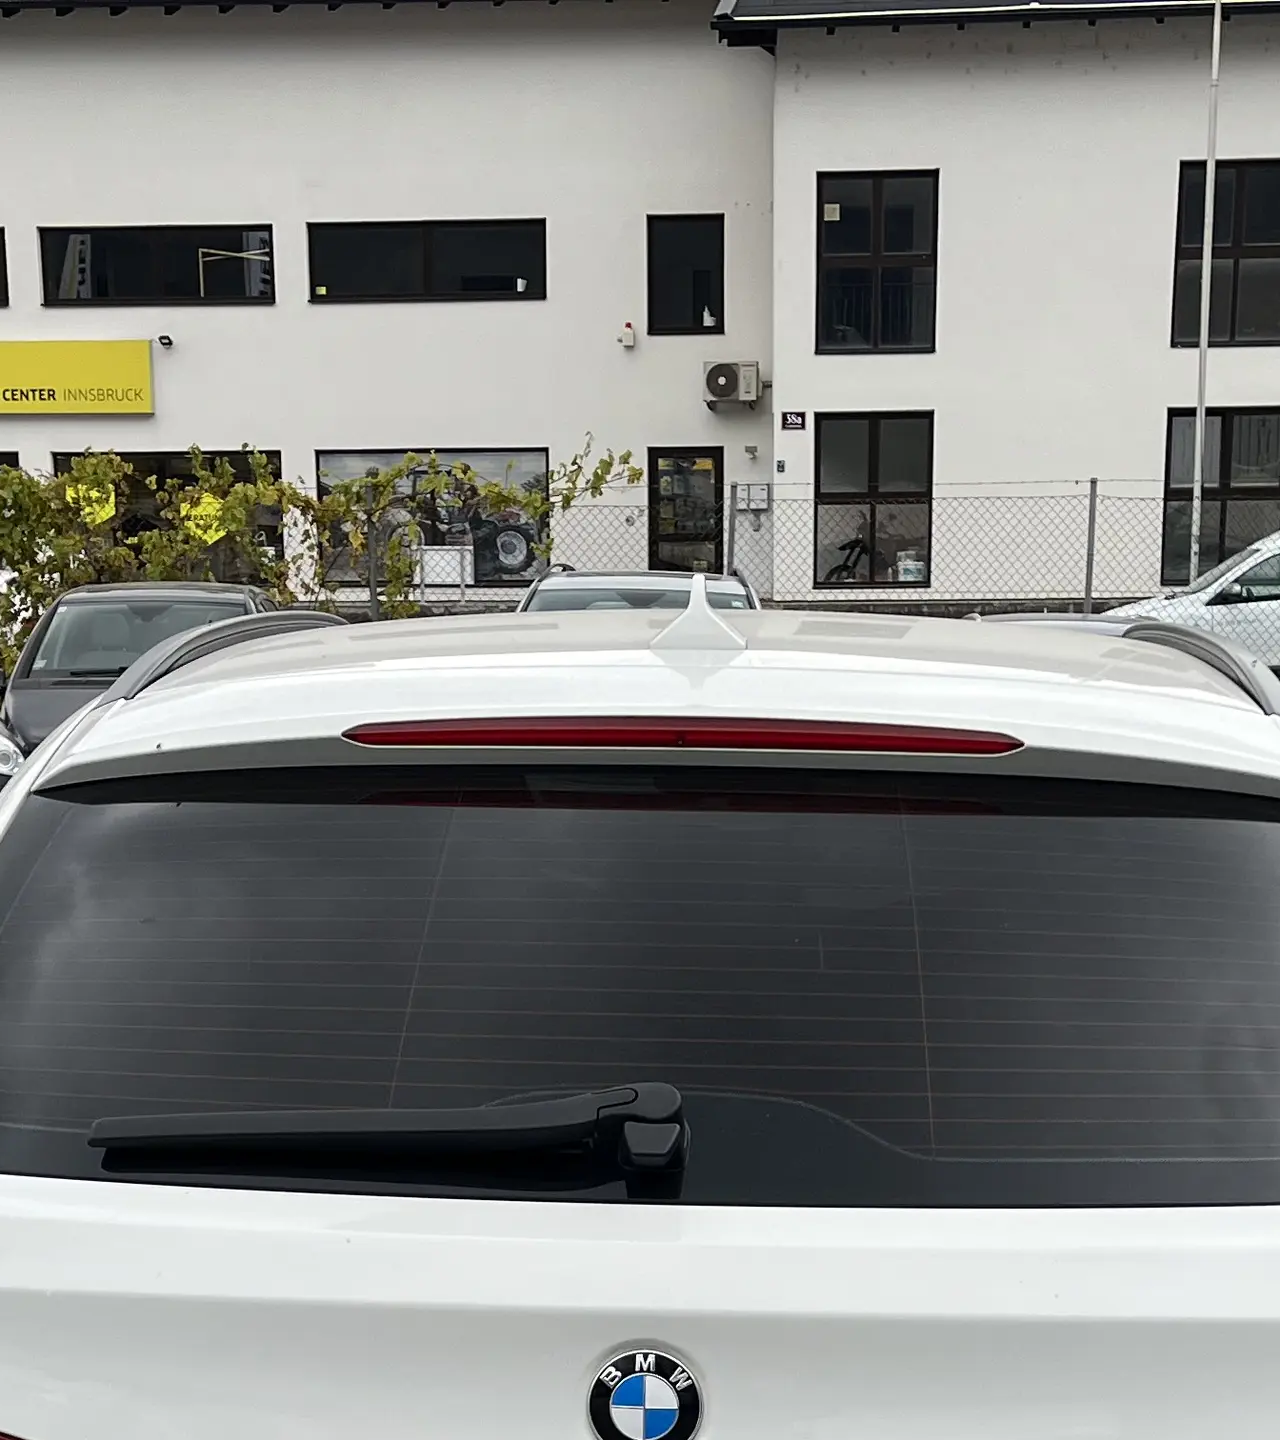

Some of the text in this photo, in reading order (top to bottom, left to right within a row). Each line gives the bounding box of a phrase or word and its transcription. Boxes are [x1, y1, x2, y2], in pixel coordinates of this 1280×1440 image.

[2, 389, 57, 401] CENTER
[63, 388, 144, 401] INNSBRUCK
[599, 1352, 693, 1392] BMW
